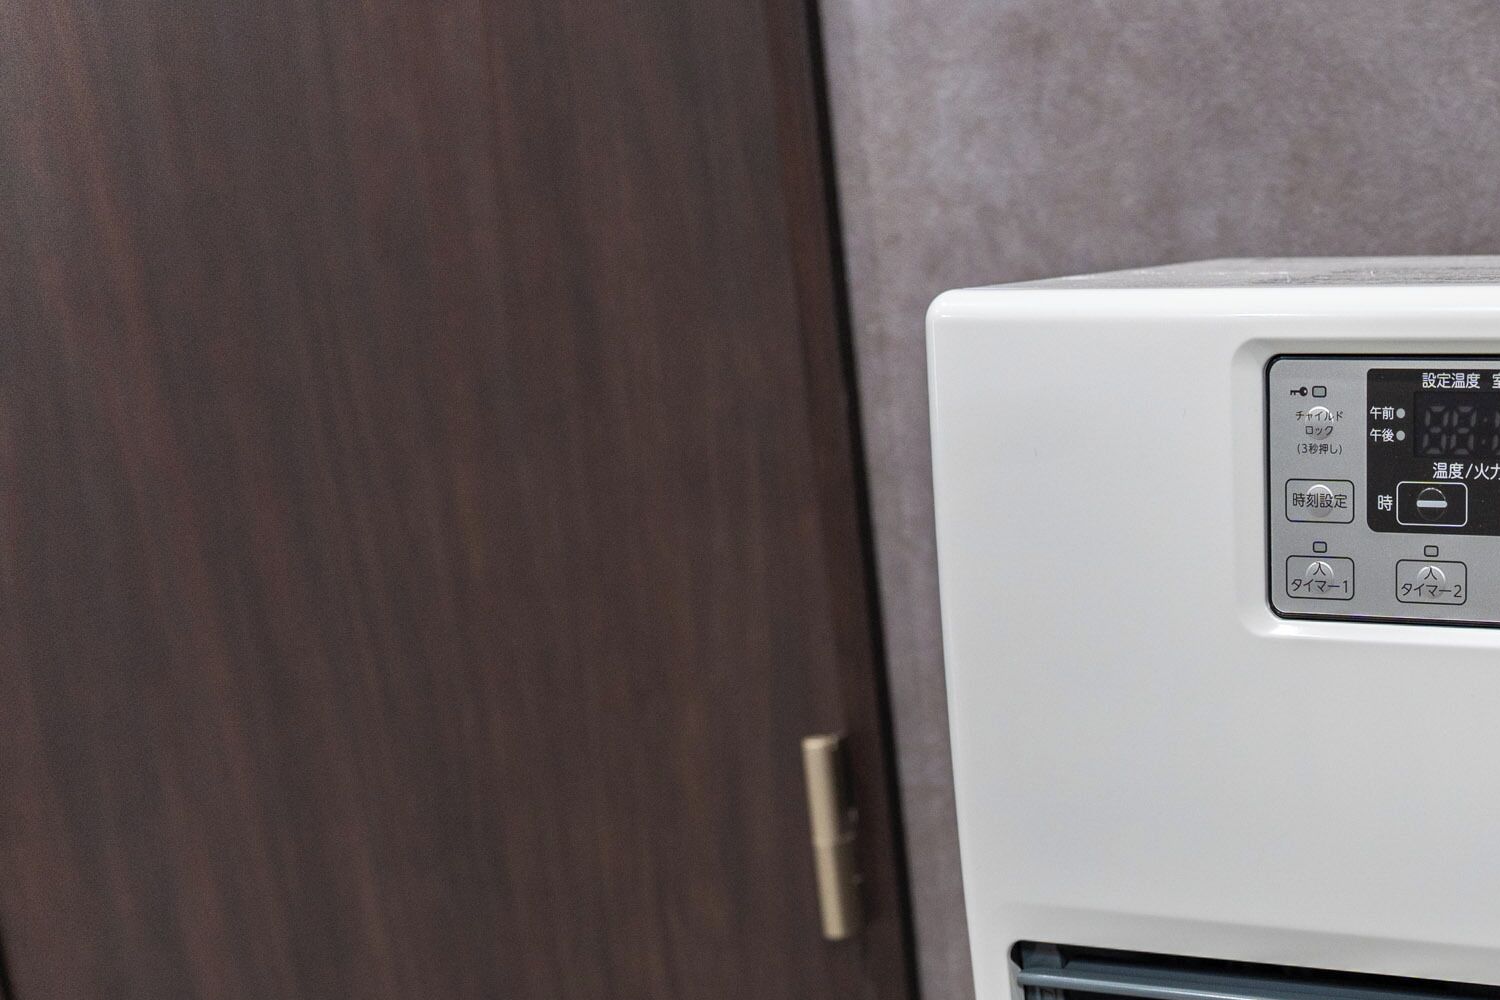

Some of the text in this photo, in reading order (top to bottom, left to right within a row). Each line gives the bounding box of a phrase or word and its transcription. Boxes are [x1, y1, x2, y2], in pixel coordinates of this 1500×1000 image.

[1422, 372, 1481, 389] 設定温度
[1295, 410, 1344, 421] チャイルド
[1369, 406, 1395, 420] 午前
[1305, 425, 1334, 436] ロック
[1369, 428, 1395, 443] 午後
[1292, 492, 1348, 509] 時刻設定
[1377, 494, 1393, 512] 時
[1291, 578, 1348, 593] タイマー1
[1401, 583, 1463, 598] タイマー2
